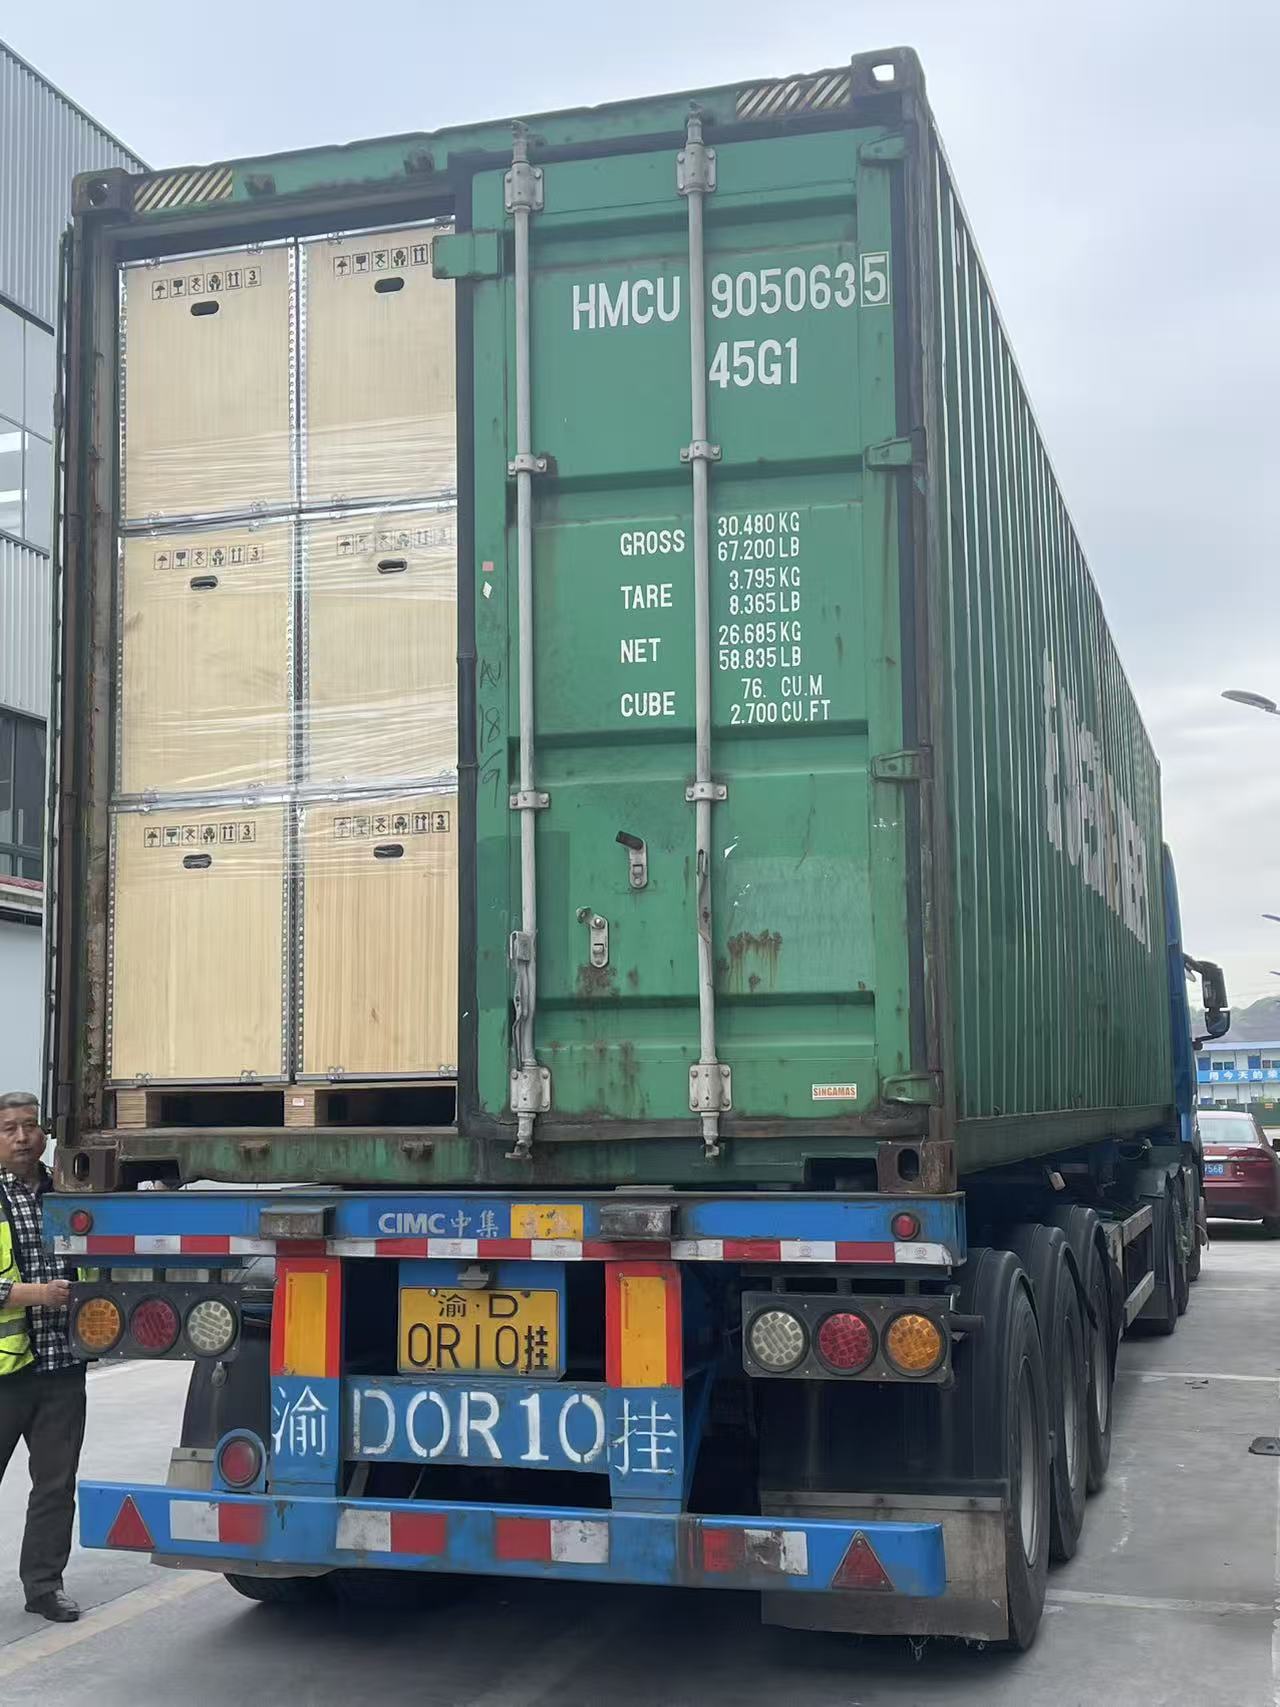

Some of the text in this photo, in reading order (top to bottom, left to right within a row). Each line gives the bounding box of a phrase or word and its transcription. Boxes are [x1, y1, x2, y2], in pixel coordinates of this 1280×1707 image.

[572, 276, 681, 330] HMCU
[709, 337, 798, 388] 45G1
[620, 529, 686, 556] GROSS
[620, 583, 673, 610] TARE
[620, 638, 661, 663] NET
[620, 691, 676, 717] CUBE
[813, 1087, 856, 1097] SINGAMAS
[378, 1212, 446, 1235] CIMC
[450, 1209, 500, 1238] 中集
